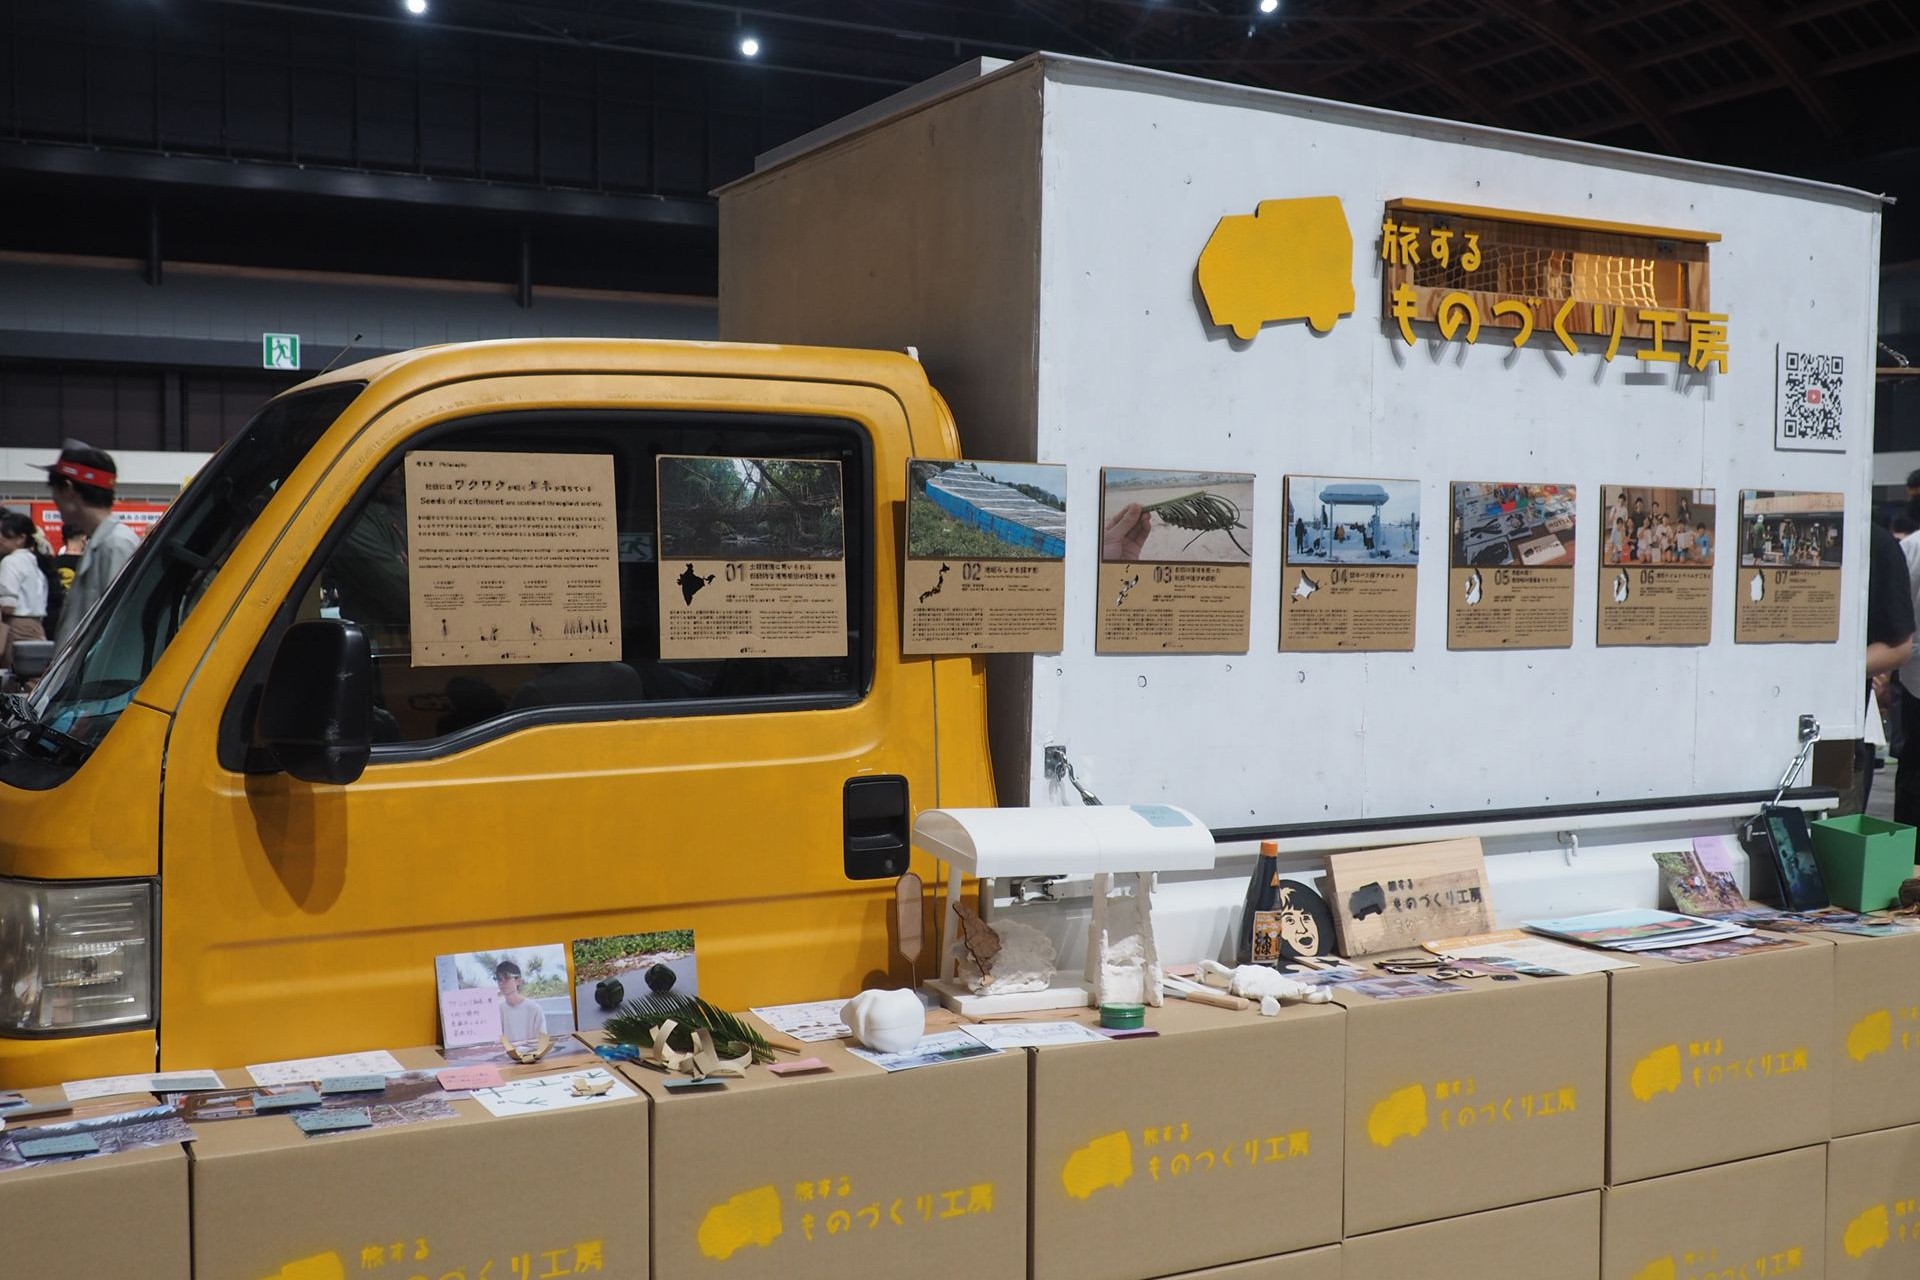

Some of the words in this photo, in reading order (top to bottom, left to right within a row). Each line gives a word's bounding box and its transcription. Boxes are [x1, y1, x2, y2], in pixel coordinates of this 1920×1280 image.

[1382, 218, 1481, 272] 旅する
[1392, 283, 1729, 374] ものづくり工房
[420, 497, 445, 505] Seeds
[447, 497, 456, 505] of
[458, 497, 504, 506] excitement
[726, 563, 746, 582] 01
[963, 563, 982, 581] 02
[1153, 566, 1172, 584] 03
[1331, 568, 1348, 585] 04
[1494, 569, 1510, 585] 05
[1640, 569, 1654, 585] 06
[1775, 570, 1788, 585] 07
[1393, 887, 1482, 913] ものづくり工房
[802, 1182, 994, 1242] ものづくり工房
